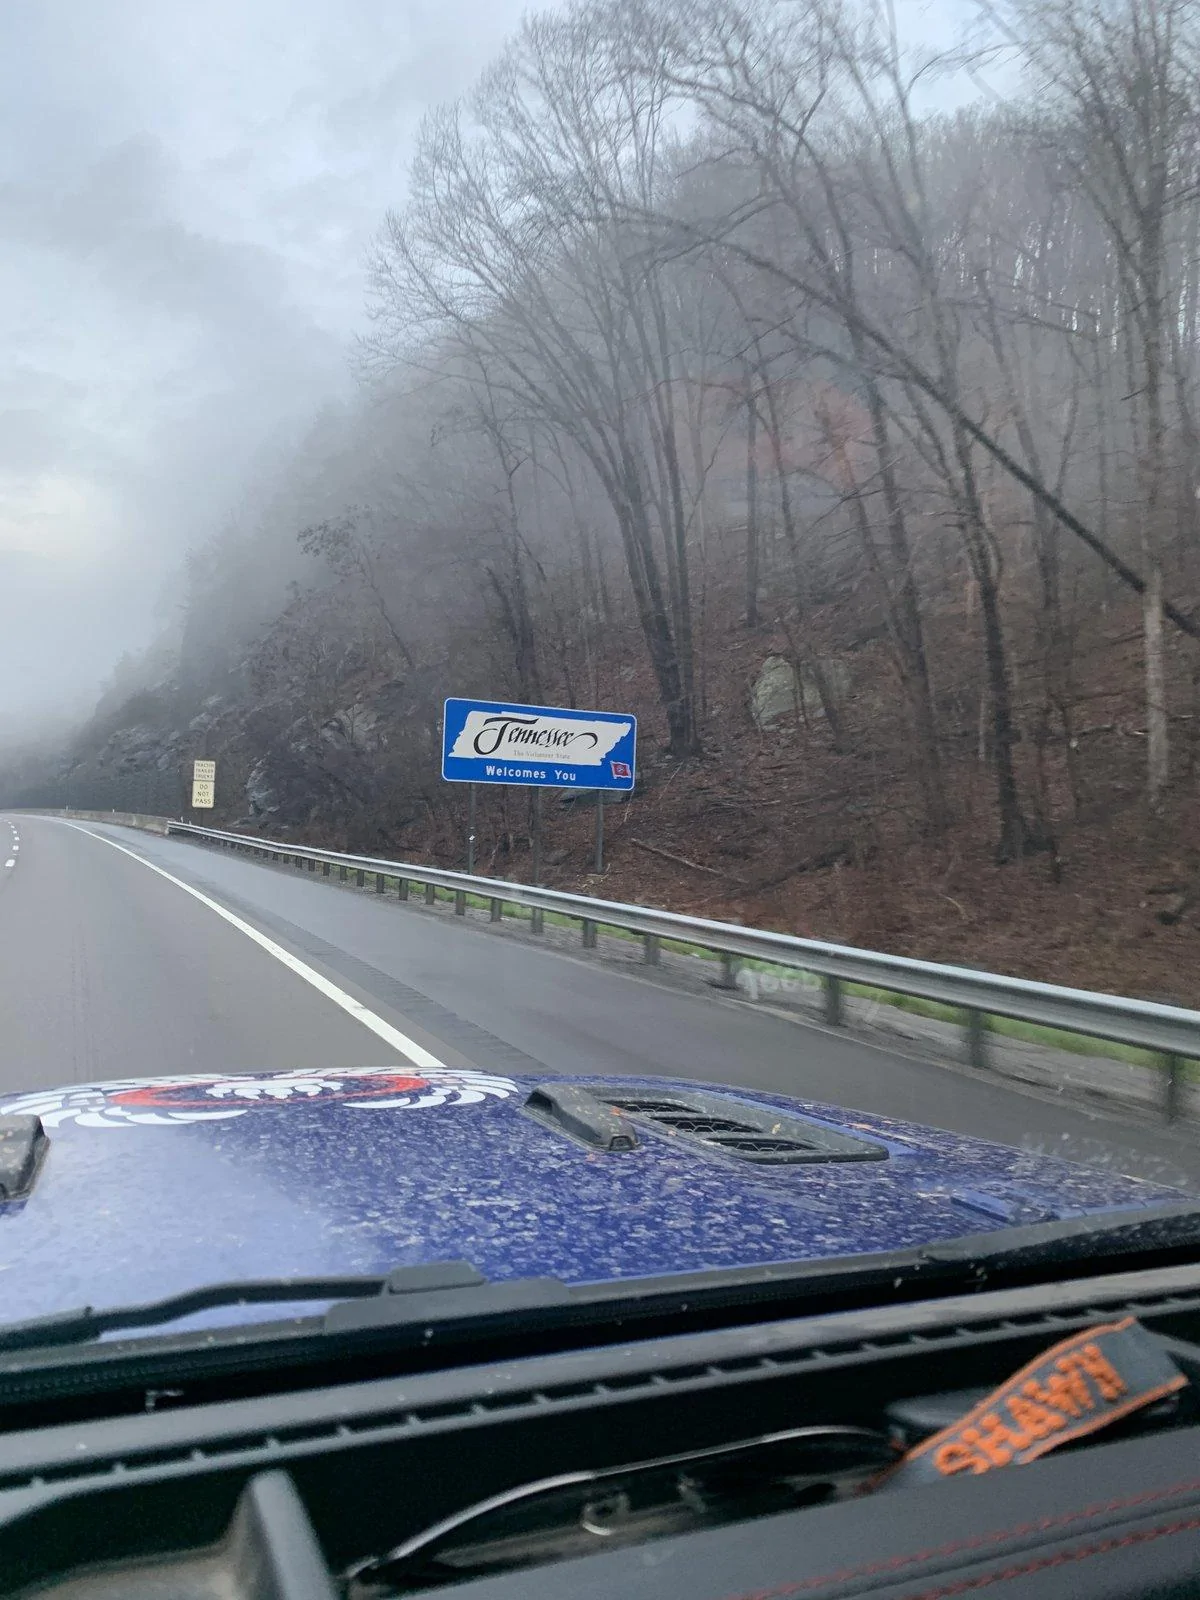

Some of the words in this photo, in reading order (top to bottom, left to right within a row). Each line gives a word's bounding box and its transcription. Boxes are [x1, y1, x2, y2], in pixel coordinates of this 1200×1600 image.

[474, 716, 598, 755] Tennessee
[526, 750, 554, 759] Voleer
[486, 765, 546, 779] Welcomes
[554, 769, 576, 781] You
[935, 1344, 1127, 1475] SHAWN
